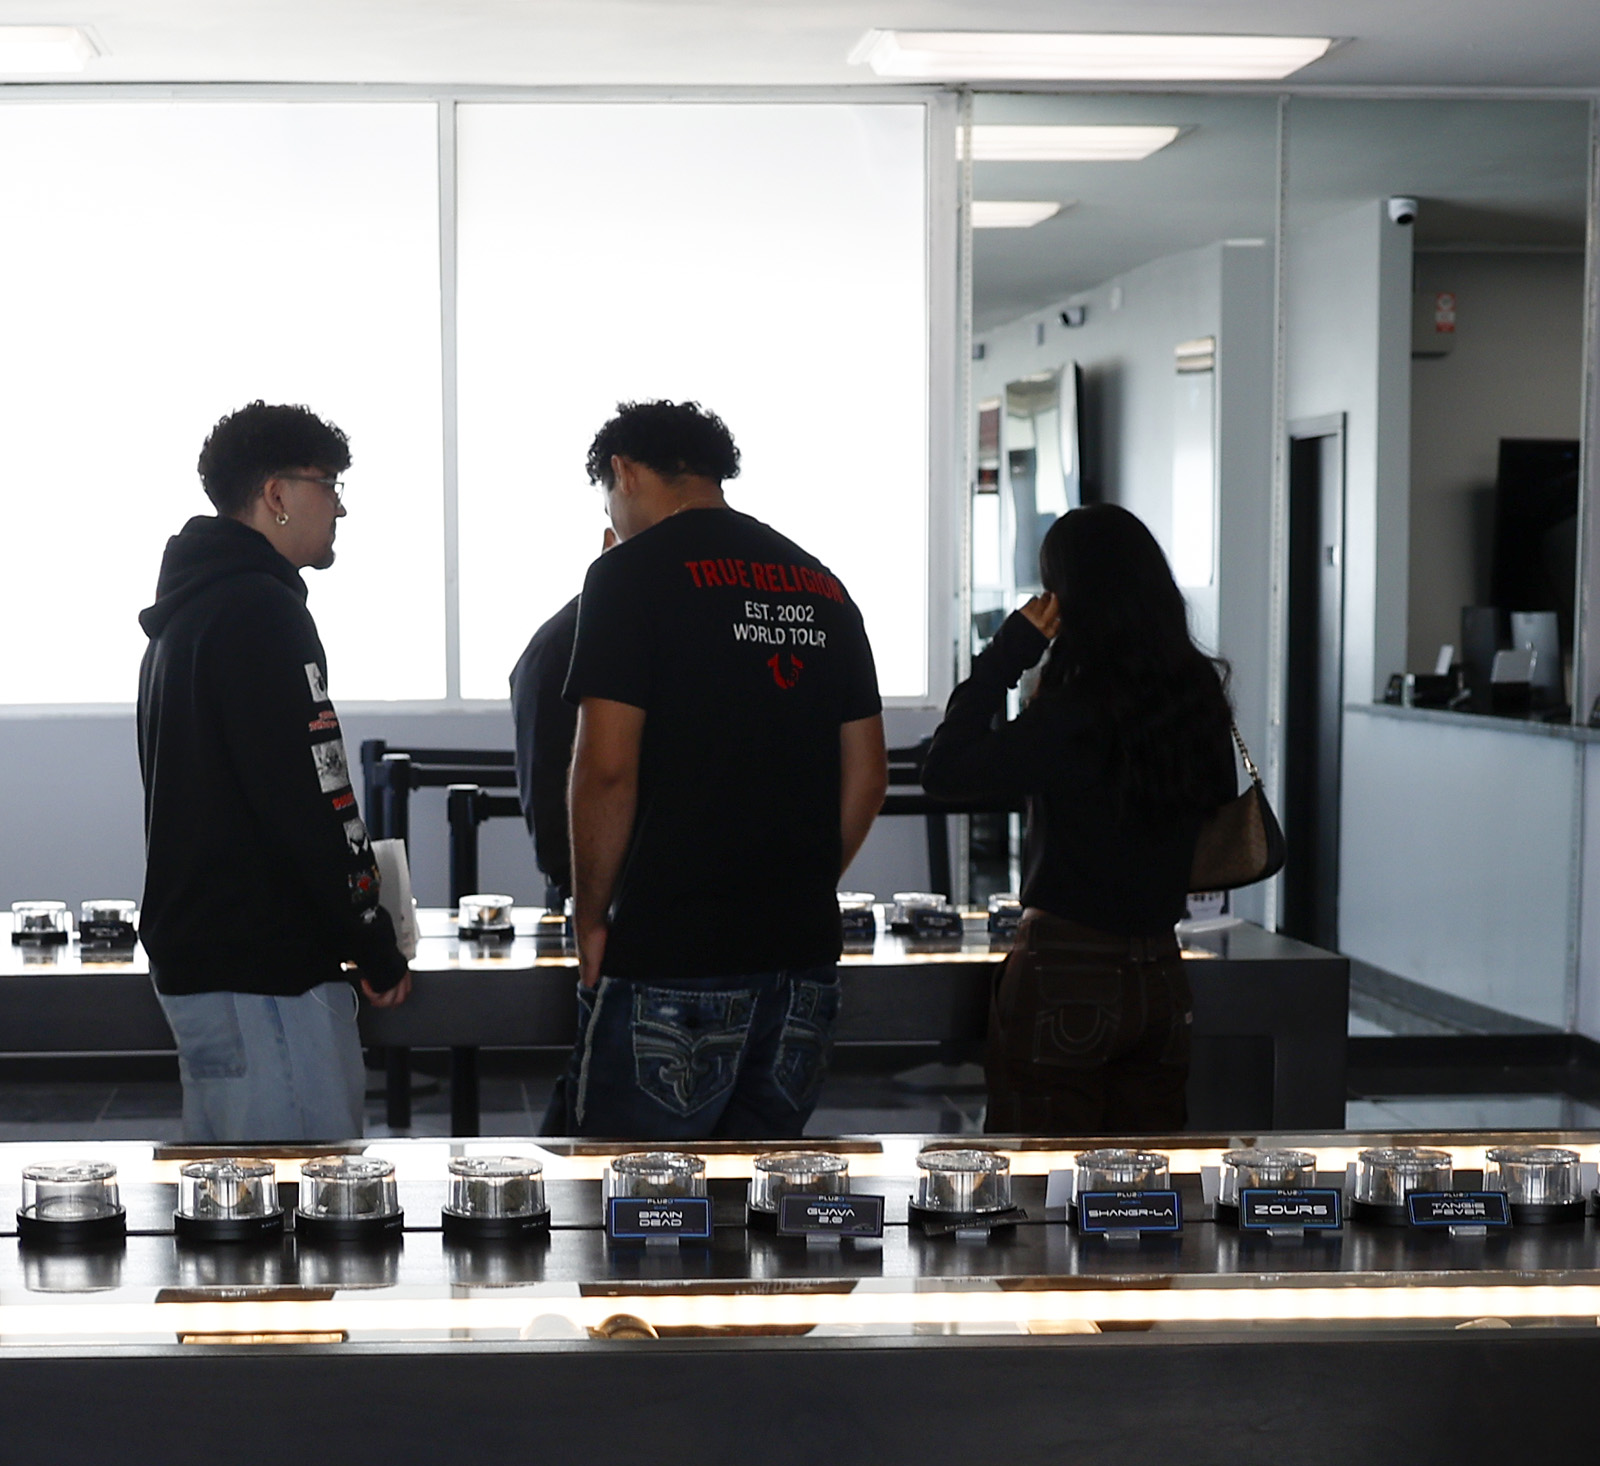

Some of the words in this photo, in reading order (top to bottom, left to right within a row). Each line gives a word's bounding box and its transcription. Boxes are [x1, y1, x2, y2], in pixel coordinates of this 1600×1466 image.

[684, 558, 751, 588] TRUE
[750, 561, 845, 604] RELIGION
[744, 600, 775, 622] EST.
[777, 604, 815, 622] 2002
[733, 622, 786, 645] WORLD
[789, 627, 826, 648] TOUR
[807, 1207, 855, 1217] GUAVA
[1254, 1204, 1328, 1215] ZOURS
[1433, 1208, 1486, 1216] FEVER
[638, 1211, 683, 1219] BRAIN
[639, 1218, 682, 1227] DEAD
